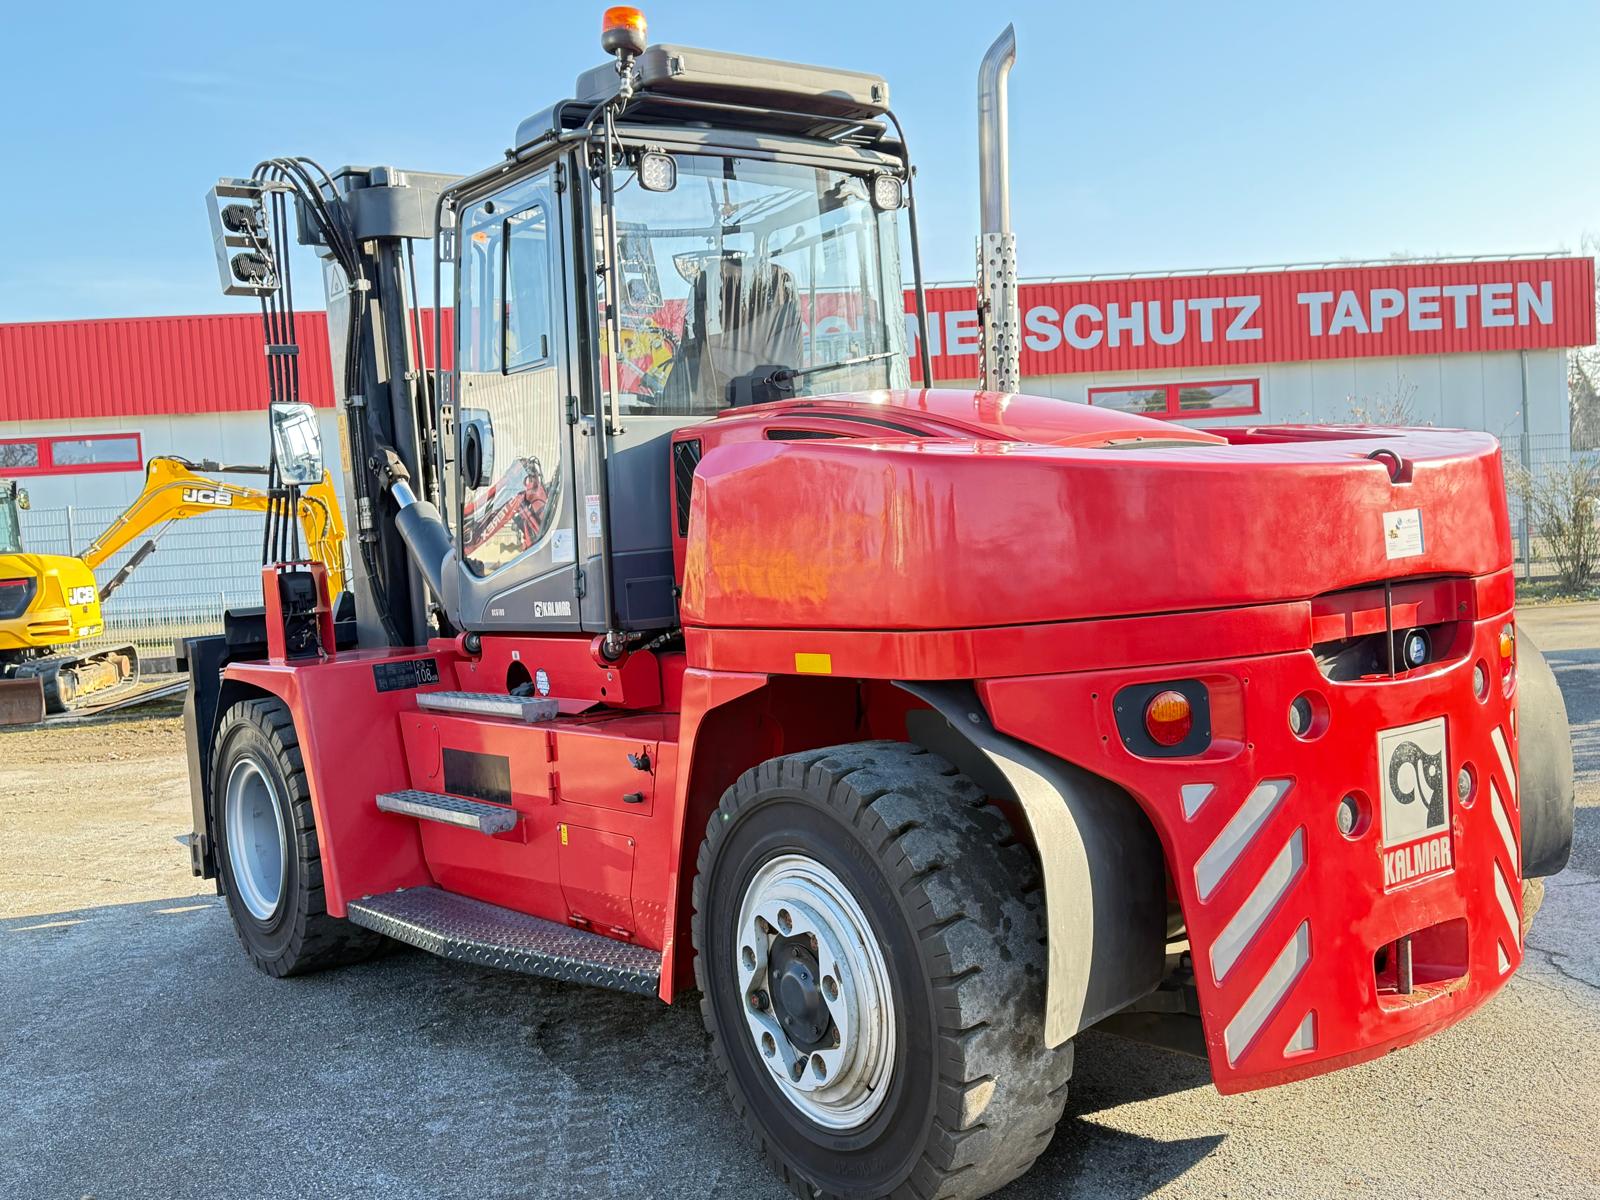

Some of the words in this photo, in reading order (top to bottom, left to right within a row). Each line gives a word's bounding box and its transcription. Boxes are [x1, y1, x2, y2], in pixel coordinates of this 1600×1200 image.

[803, 293, 1264, 362] NESCHUTZ
[1298, 280, 1555, 337] TAPETEN
[183, 488, 233, 506] JCB
[69, 585, 95, 606] JCB
[542, 600, 572, 617] KALMAR
[416, 667, 432, 683] 108
[1383, 834, 1452, 886] KALMAR
